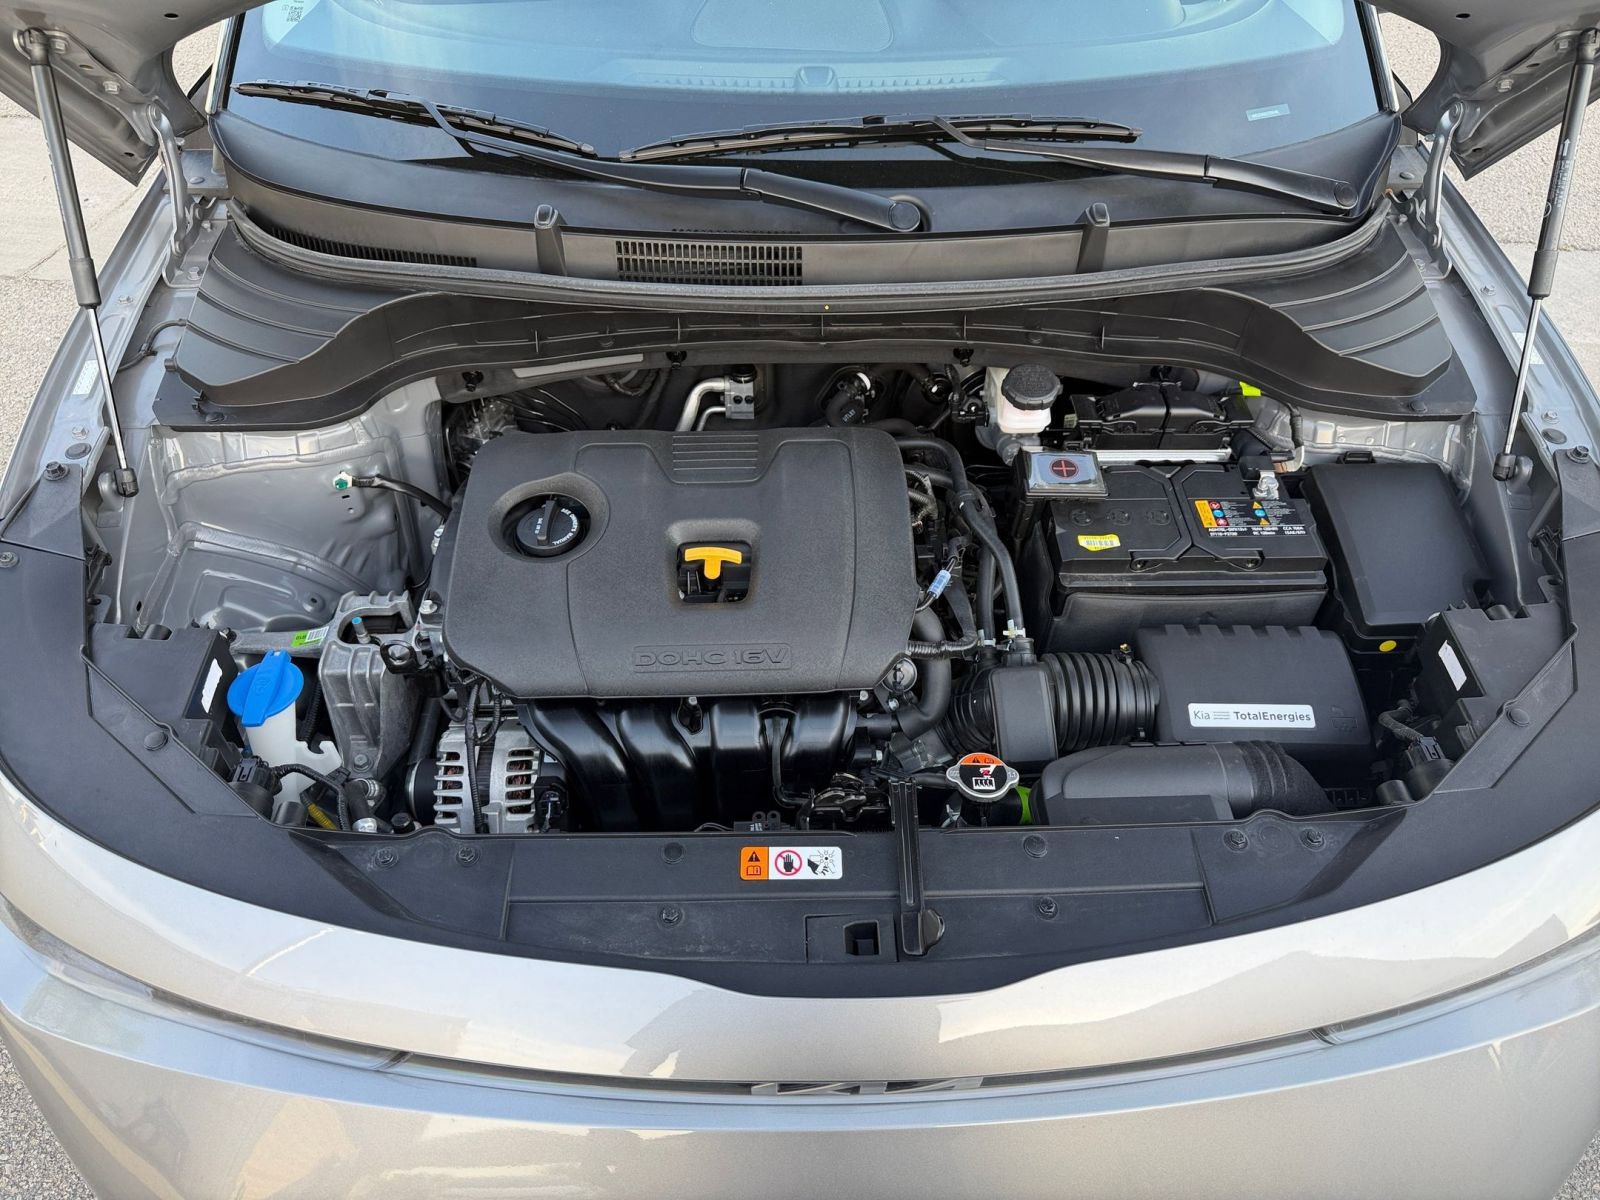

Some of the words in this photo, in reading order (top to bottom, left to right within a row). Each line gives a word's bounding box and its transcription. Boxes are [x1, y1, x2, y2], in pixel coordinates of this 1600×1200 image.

[634, 651, 727, 667] DOHC
[734, 648, 789, 665] 16V
[1193, 710, 1211, 720] Kia
[1233, 711, 1312, 723] TotalEnergies
